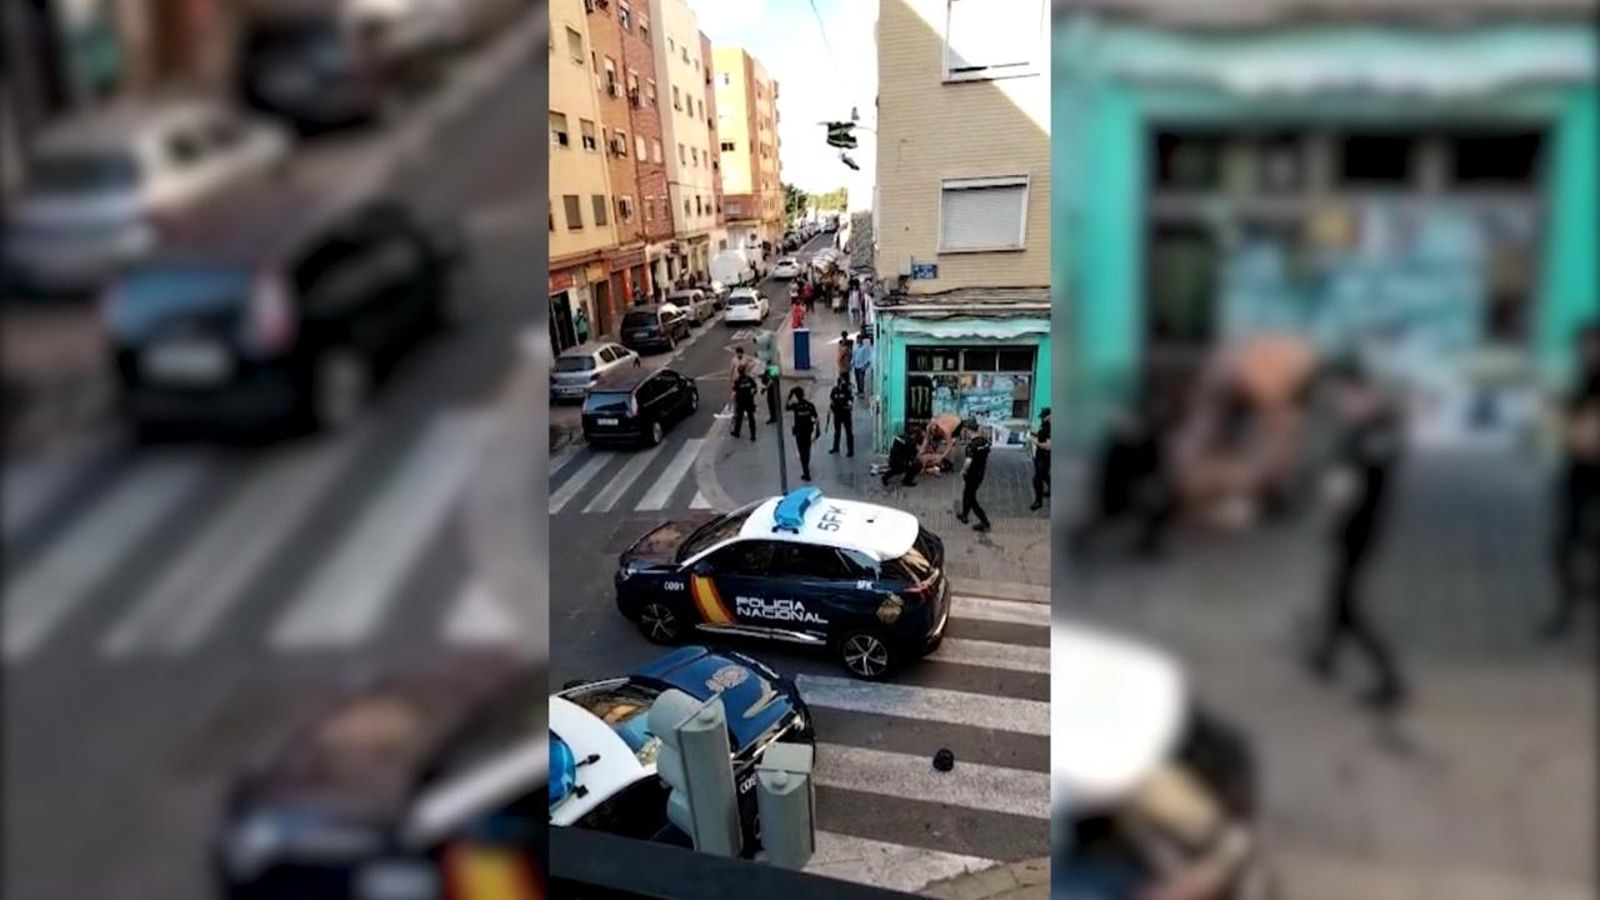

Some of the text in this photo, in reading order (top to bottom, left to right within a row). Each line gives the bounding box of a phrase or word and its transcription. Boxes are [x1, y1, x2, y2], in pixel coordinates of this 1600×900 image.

[817, 505, 847, 531] 5FK
[736, 596, 805, 612] POLICIA
[737, 607, 829, 624] NACIONAL
